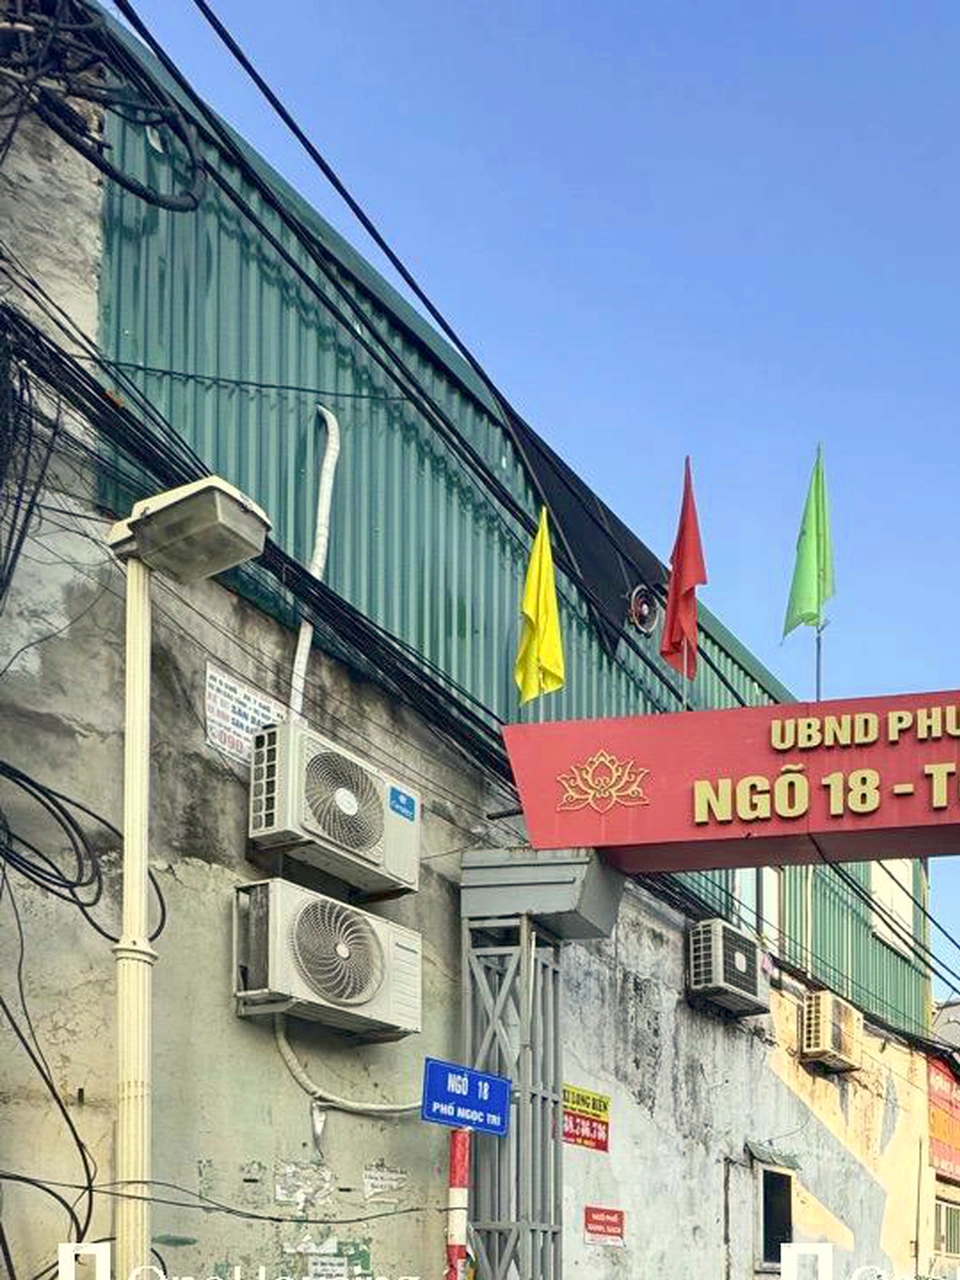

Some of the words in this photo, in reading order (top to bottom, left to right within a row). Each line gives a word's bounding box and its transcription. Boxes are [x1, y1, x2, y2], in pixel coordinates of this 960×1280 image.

[770, 711, 879, 751] UBND
[693, 763, 810, 824] NGÕ
[821, 768, 881, 816] 18
[892, 783, 915, 796] -
[477, 1081, 490, 1101] 18
[457, 1107, 485, 1125] NGỌC
